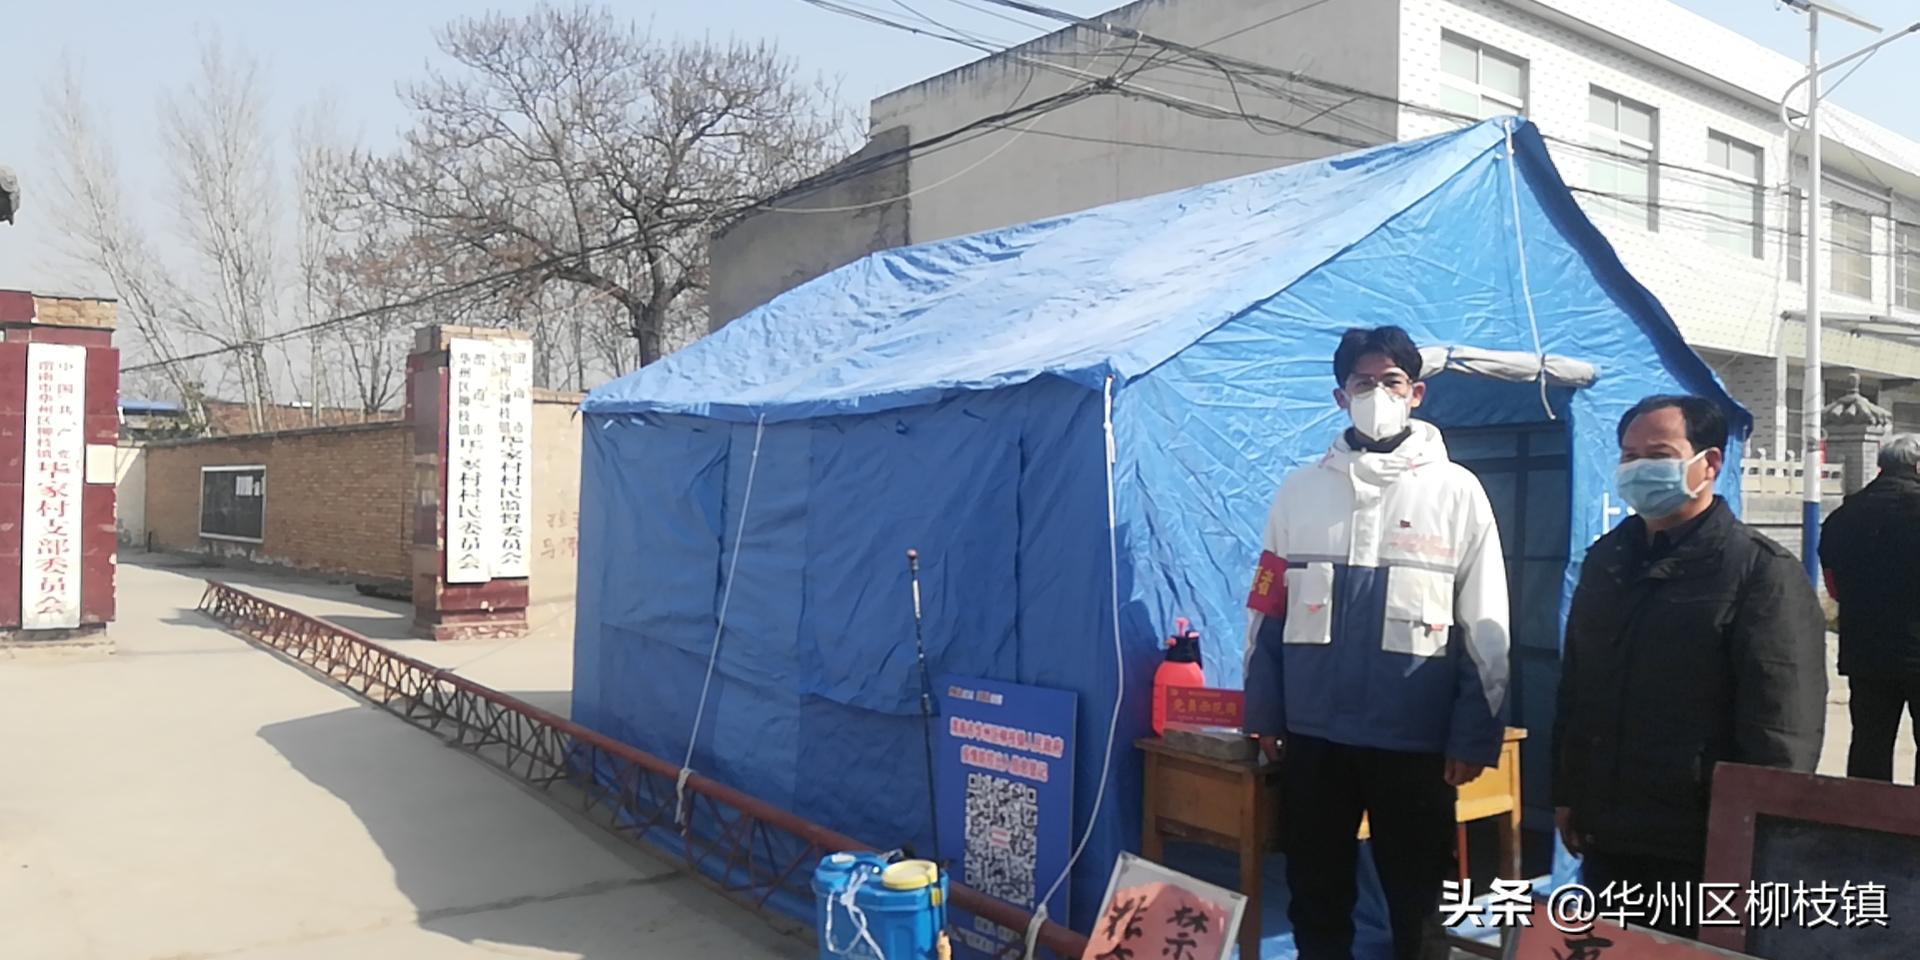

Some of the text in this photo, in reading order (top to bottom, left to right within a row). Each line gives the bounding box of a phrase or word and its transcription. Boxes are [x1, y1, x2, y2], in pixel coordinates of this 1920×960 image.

[36, 461, 70, 614] 毕家村支部委员会
[457, 438, 482, 569] 毕家村村民委员会
[499, 435, 524, 565] 毕家村村民监督委员会
